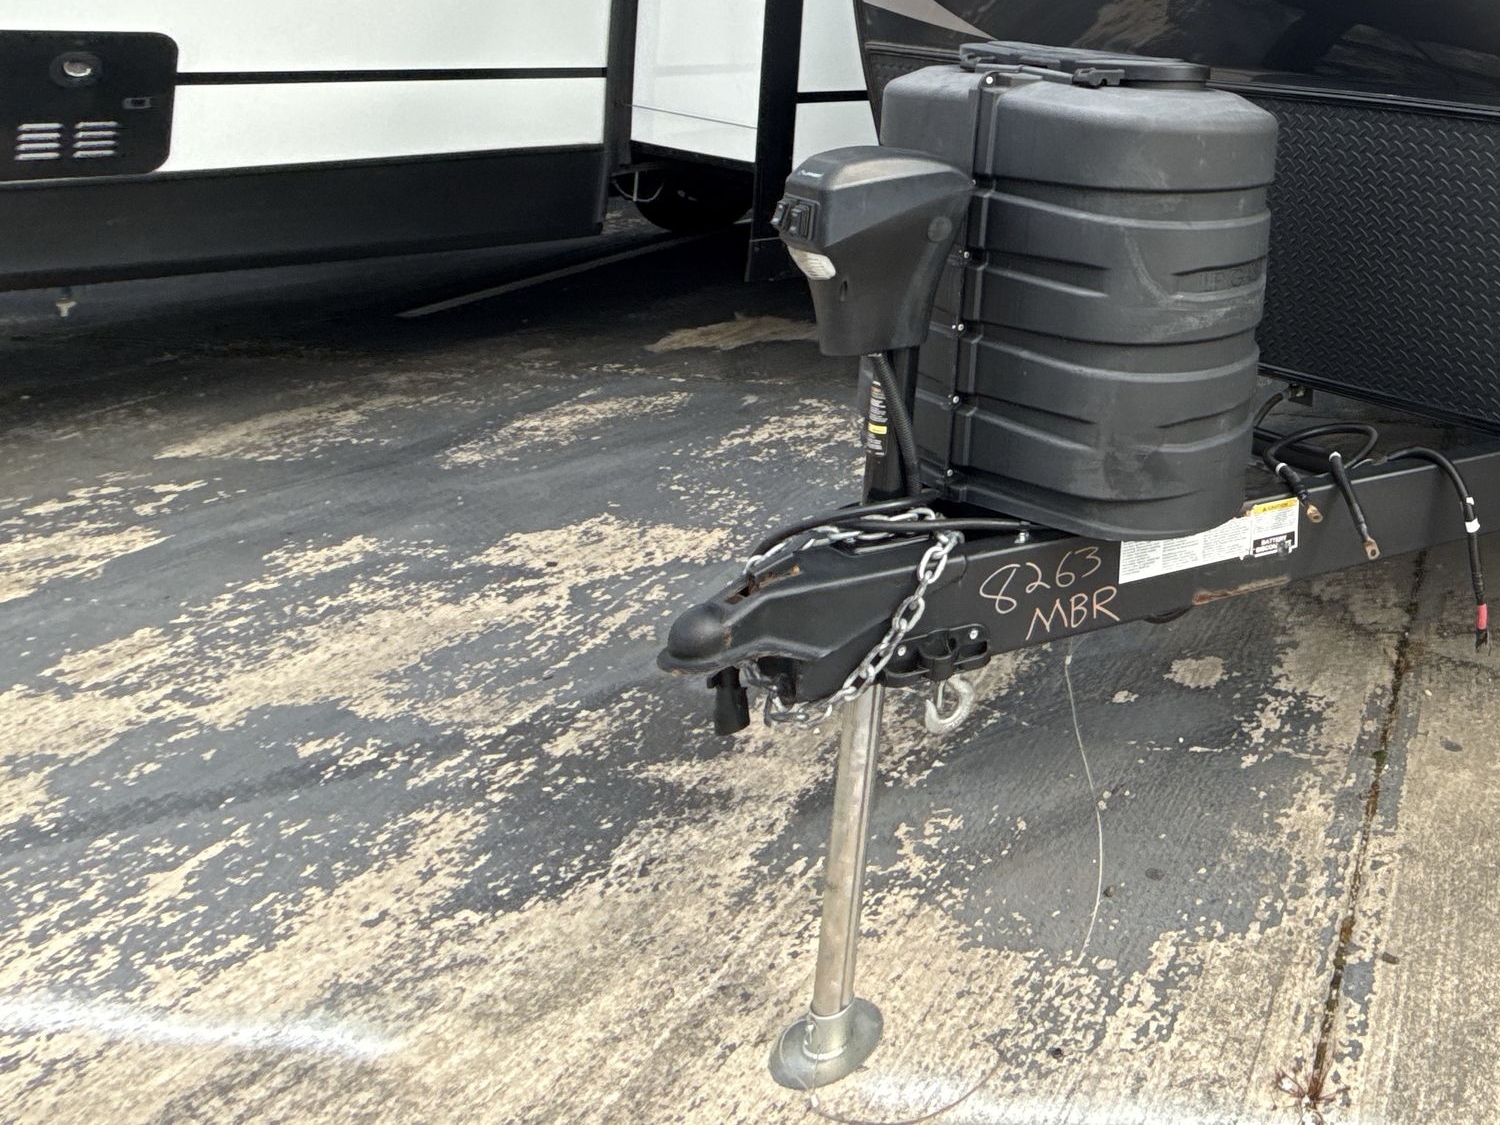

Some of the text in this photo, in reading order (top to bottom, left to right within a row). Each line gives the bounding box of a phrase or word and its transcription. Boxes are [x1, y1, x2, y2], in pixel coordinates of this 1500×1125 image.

[1260, 534, 1288, 546] BATTERY
[979, 546, 1102, 615] 8263
[1025, 585, 1121, 641] MBR
